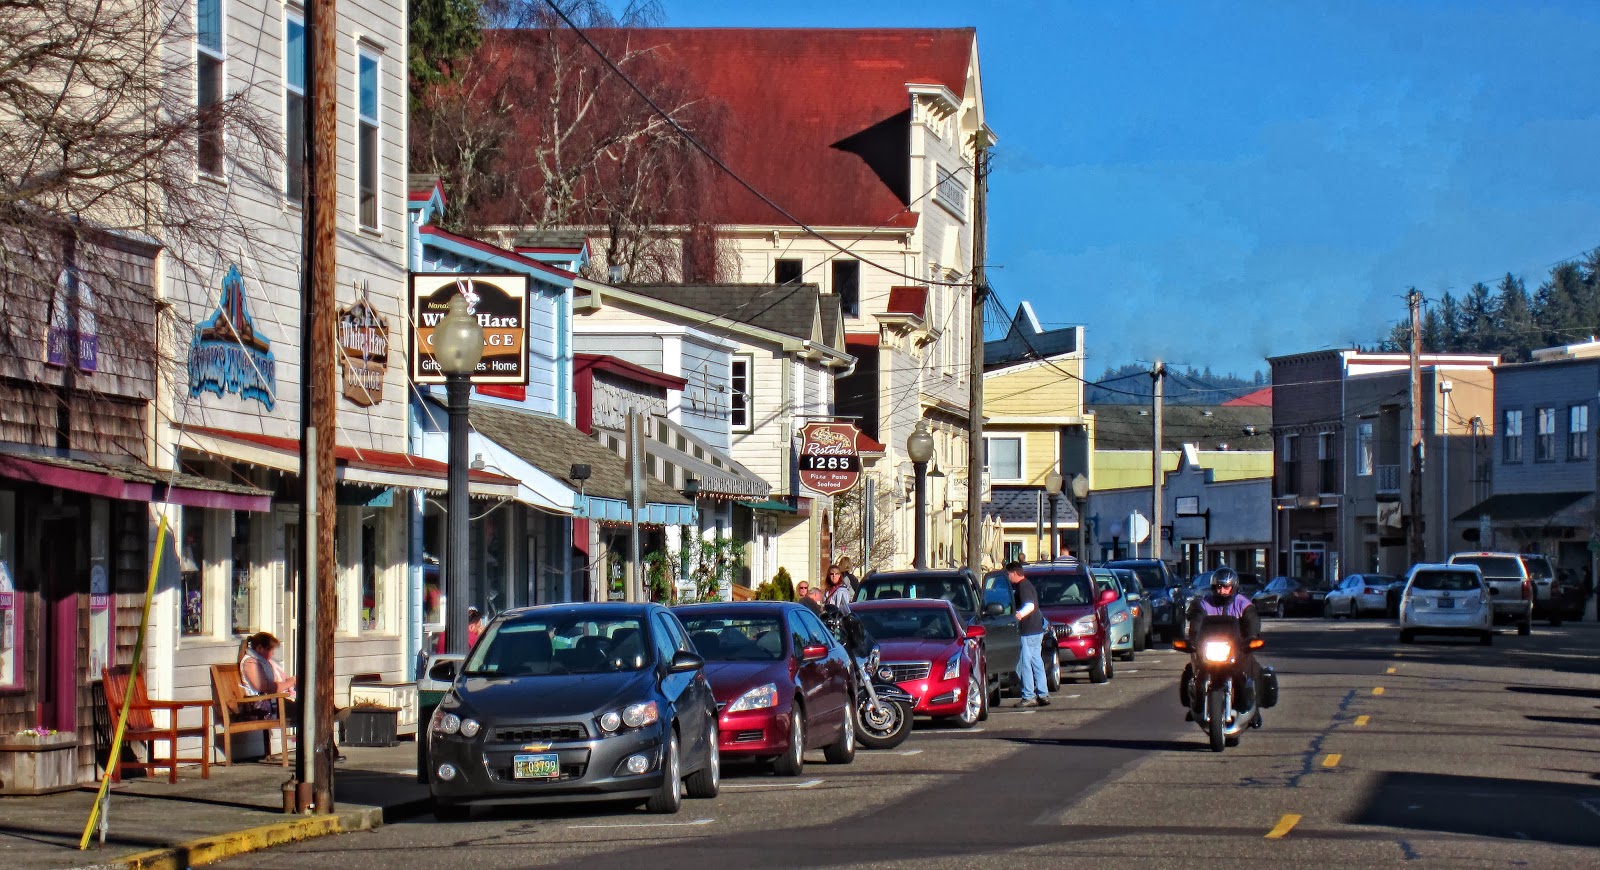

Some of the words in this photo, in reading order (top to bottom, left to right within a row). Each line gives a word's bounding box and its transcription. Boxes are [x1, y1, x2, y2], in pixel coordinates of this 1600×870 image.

[477, 313, 518, 327] Hare
[369, 328, 386, 357] Hare
[422, 360, 442, 371] Gifts
[492, 361, 517, 371] Home
[807, 443, 853, 456] Restobar
[809, 457, 849, 469] 1285
[528, 761, 556, 772] 03799
